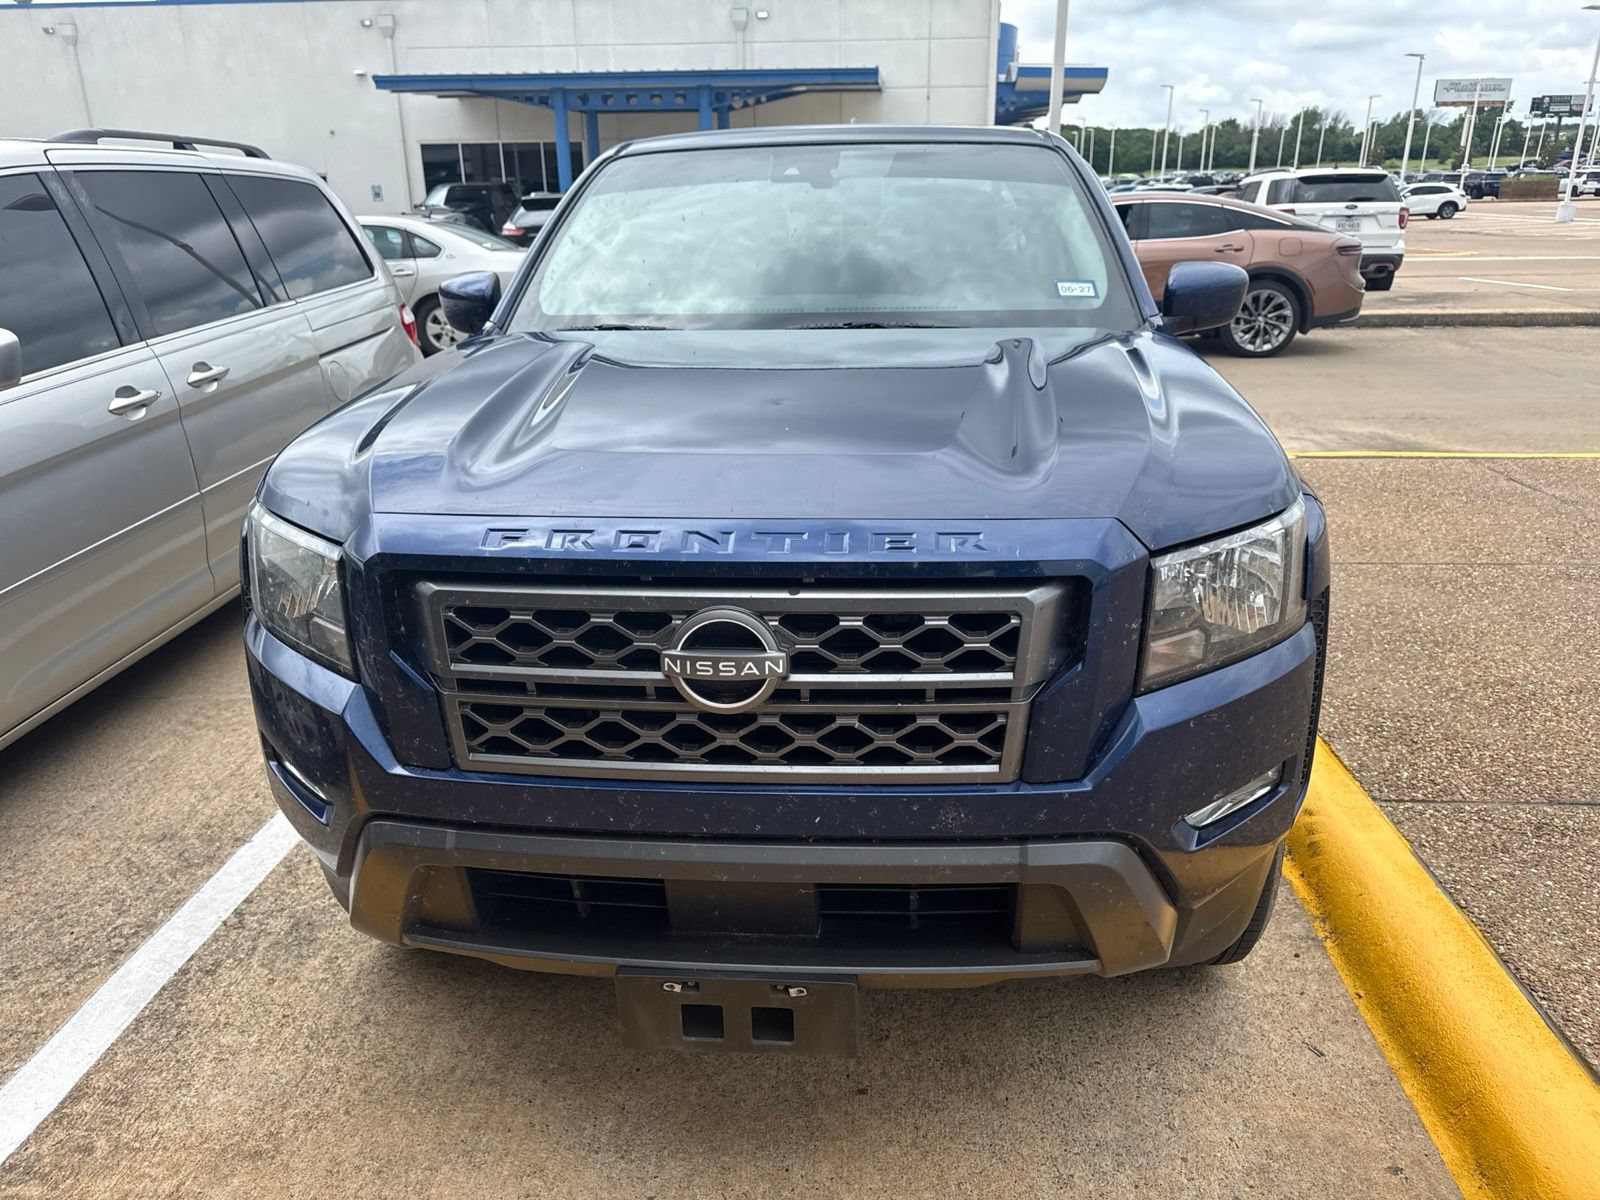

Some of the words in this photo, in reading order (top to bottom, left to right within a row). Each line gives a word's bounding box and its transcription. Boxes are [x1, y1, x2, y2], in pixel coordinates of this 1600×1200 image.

[1060, 285, 1092, 294] 06-27
[480, 528, 990, 554] FRONTIER
[664, 657, 783, 676] NISSAN
